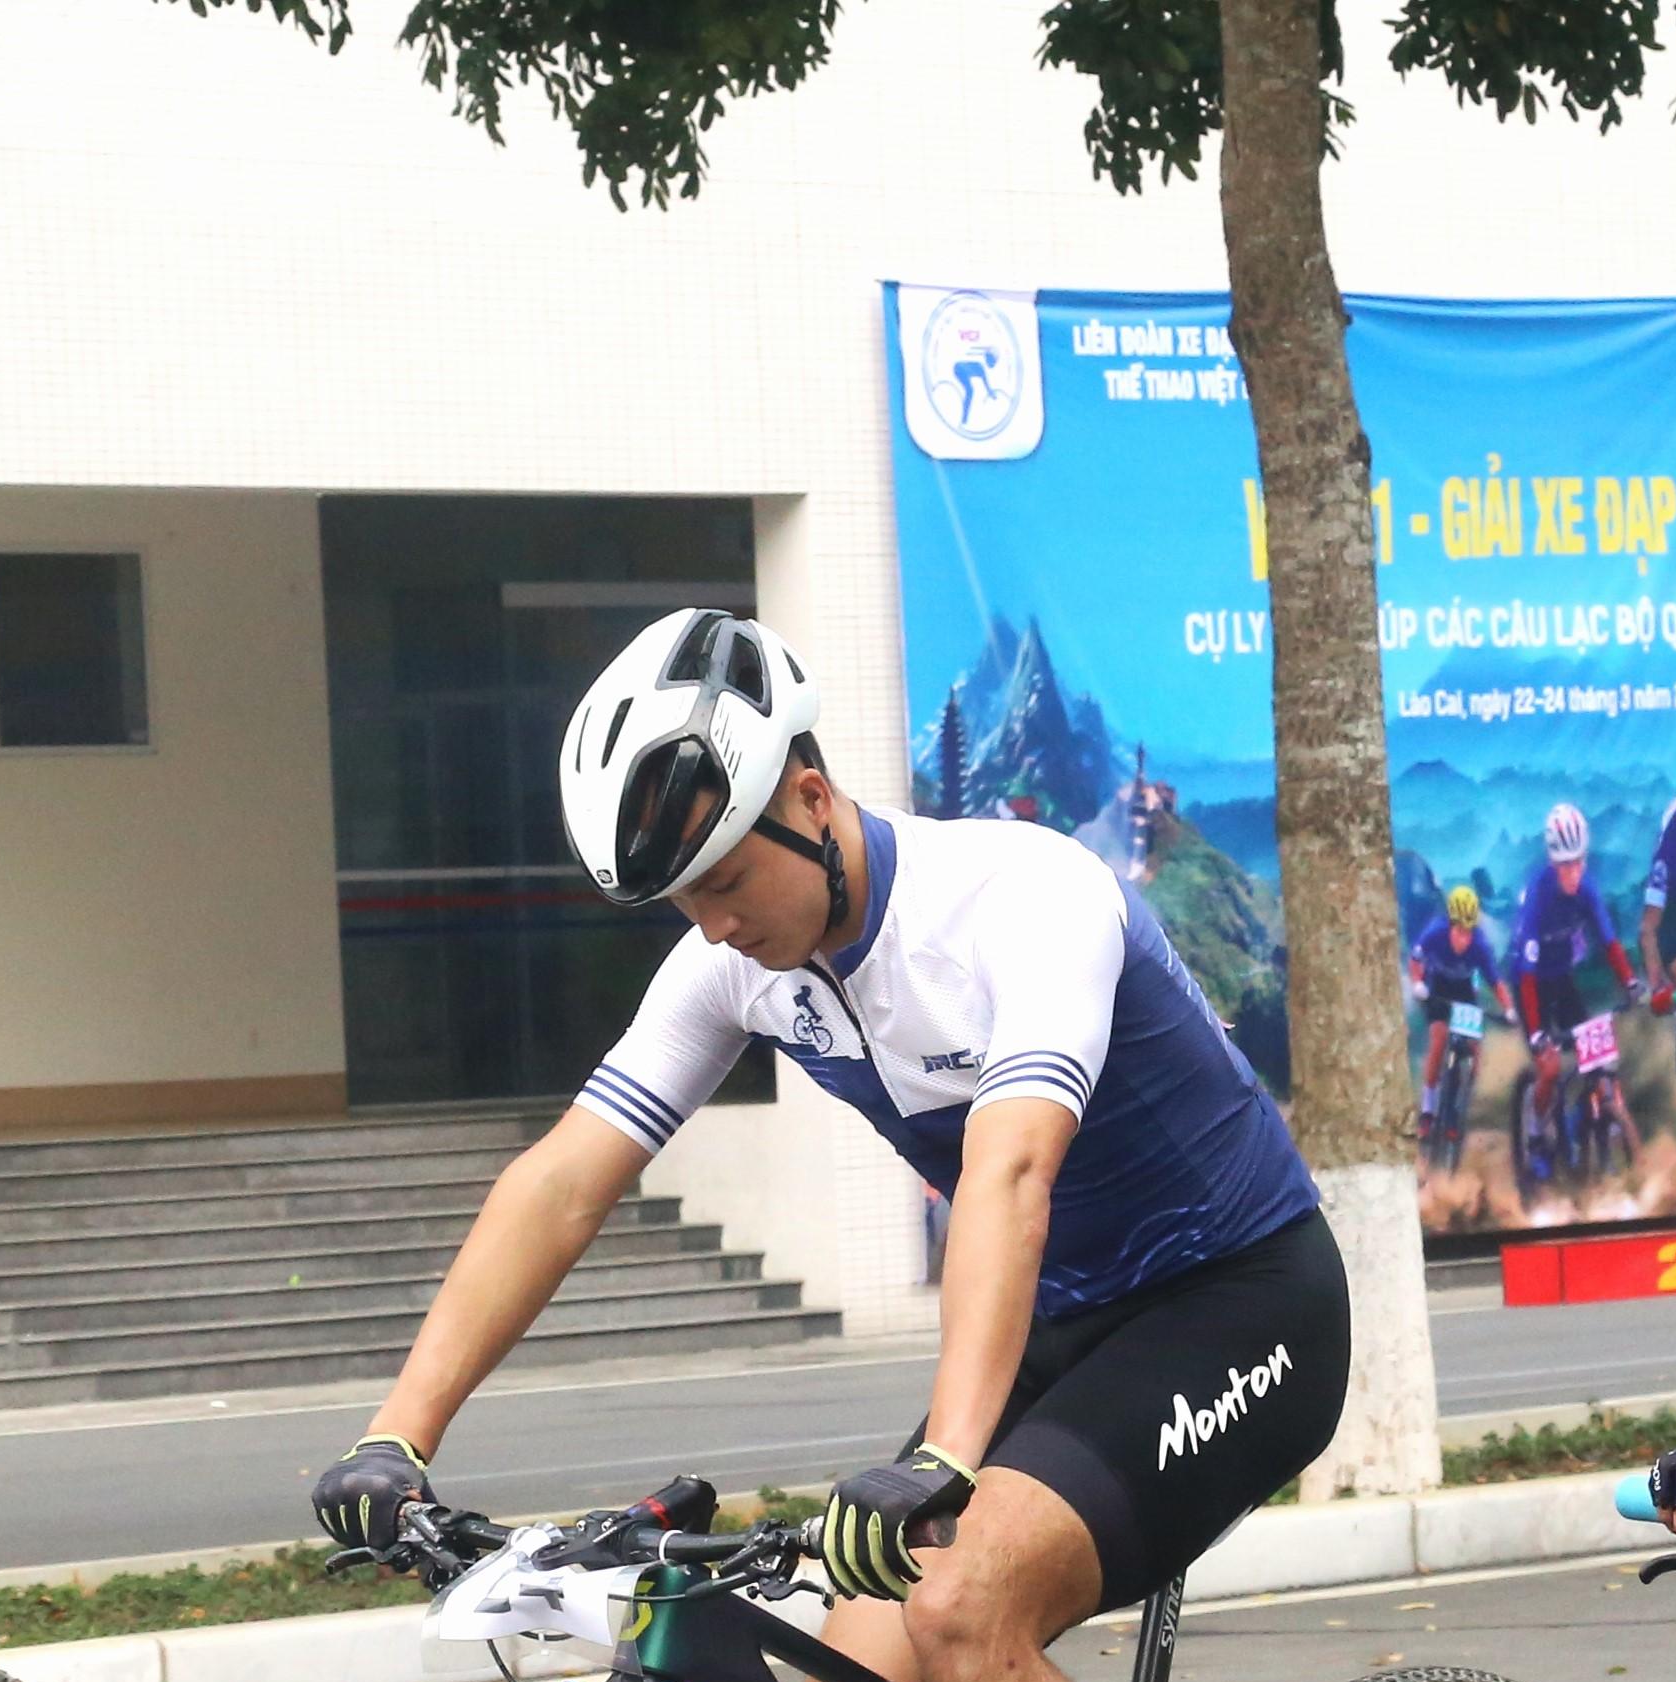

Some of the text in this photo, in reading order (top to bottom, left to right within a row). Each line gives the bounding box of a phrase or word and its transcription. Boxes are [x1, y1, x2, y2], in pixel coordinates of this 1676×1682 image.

[1073, 319, 1237, 363] LIÊN ĐOÀN XE ĐẠ
[1143, 369, 1195, 400] THAO
[1195, 363, 1238, 407] VIỆT
[1441, 452, 1523, 561] GIẢI
[1531, 475, 1587, 556] XE
[1184, 611, 1227, 665] CỰ
[1233, 611, 1267, 655] LY
[1378, 600, 1419, 650] ÚP
[1426, 596, 1485, 649] CÁC
[1490, 600, 1548, 649] CÂU
[1554, 604, 1611, 656] LẠC
[1615, 594, 1656, 654] BỘ
[1398, 689, 1431, 718] Lào
[1469, 689, 1512, 722] ngày
[1568, 683, 1619, 719] tháng
[1632, 683, 1672, 711] năm
[1158, 1343, 1294, 1472] Monton
